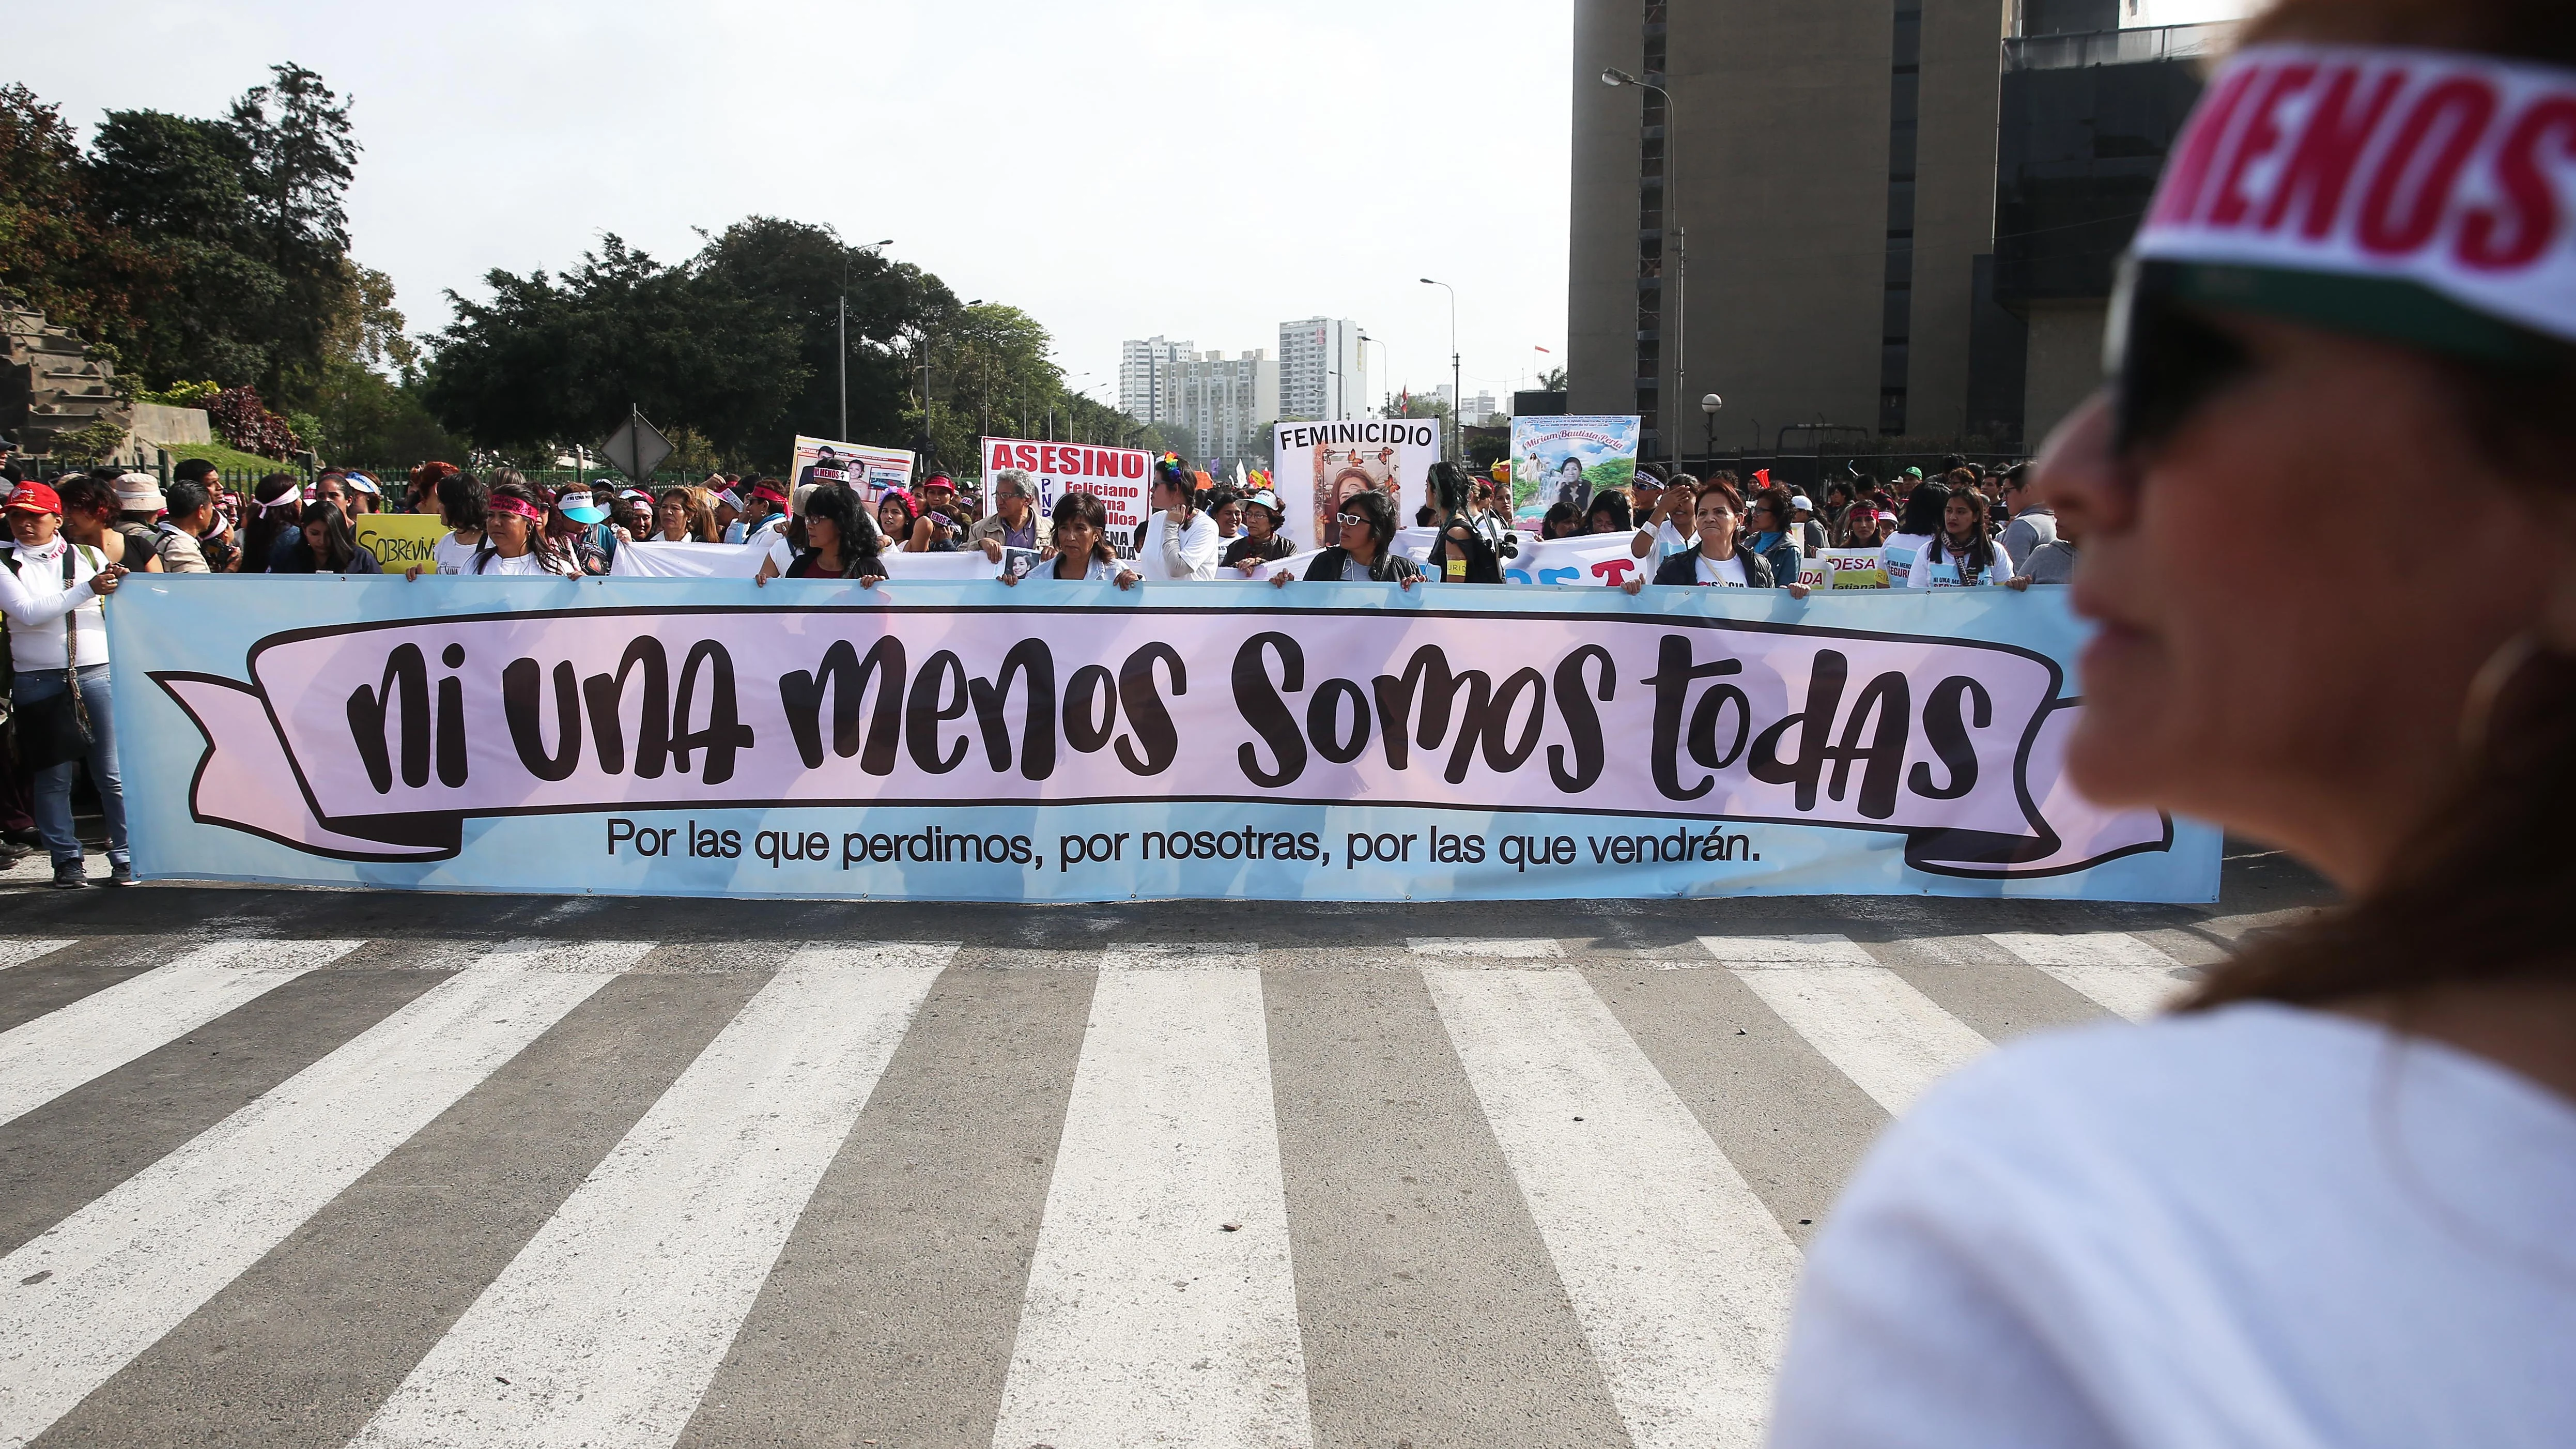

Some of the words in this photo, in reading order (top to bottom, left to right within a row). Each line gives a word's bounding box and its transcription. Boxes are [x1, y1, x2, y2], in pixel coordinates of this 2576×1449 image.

[1281, 423, 1432, 450] FEMINICIDIO
[1525, 434, 1558, 449] Miriam
[1560, 430, 1598, 439] Bautista
[1600, 434, 1624, 450] Perla
[991, 444, 1144, 479] ASESINO
[820, 468, 839, 479] MENOS
[1066, 481, 1138, 498] Feliciano
[608, 819, 676, 856] Por
[689, 820, 742, 859] las
[754, 830, 829, 868] que
[843, 826, 1043, 870] perdimos,
[1060, 833, 1130, 872] por
[1143, 825, 1330, 867] nosotras,
[1347, 833, 1417, 870] por
[1430, 825, 1486, 864] las
[1499, 835, 1576, 873] que
[1587, 826, 1760, 864] vendrán.
